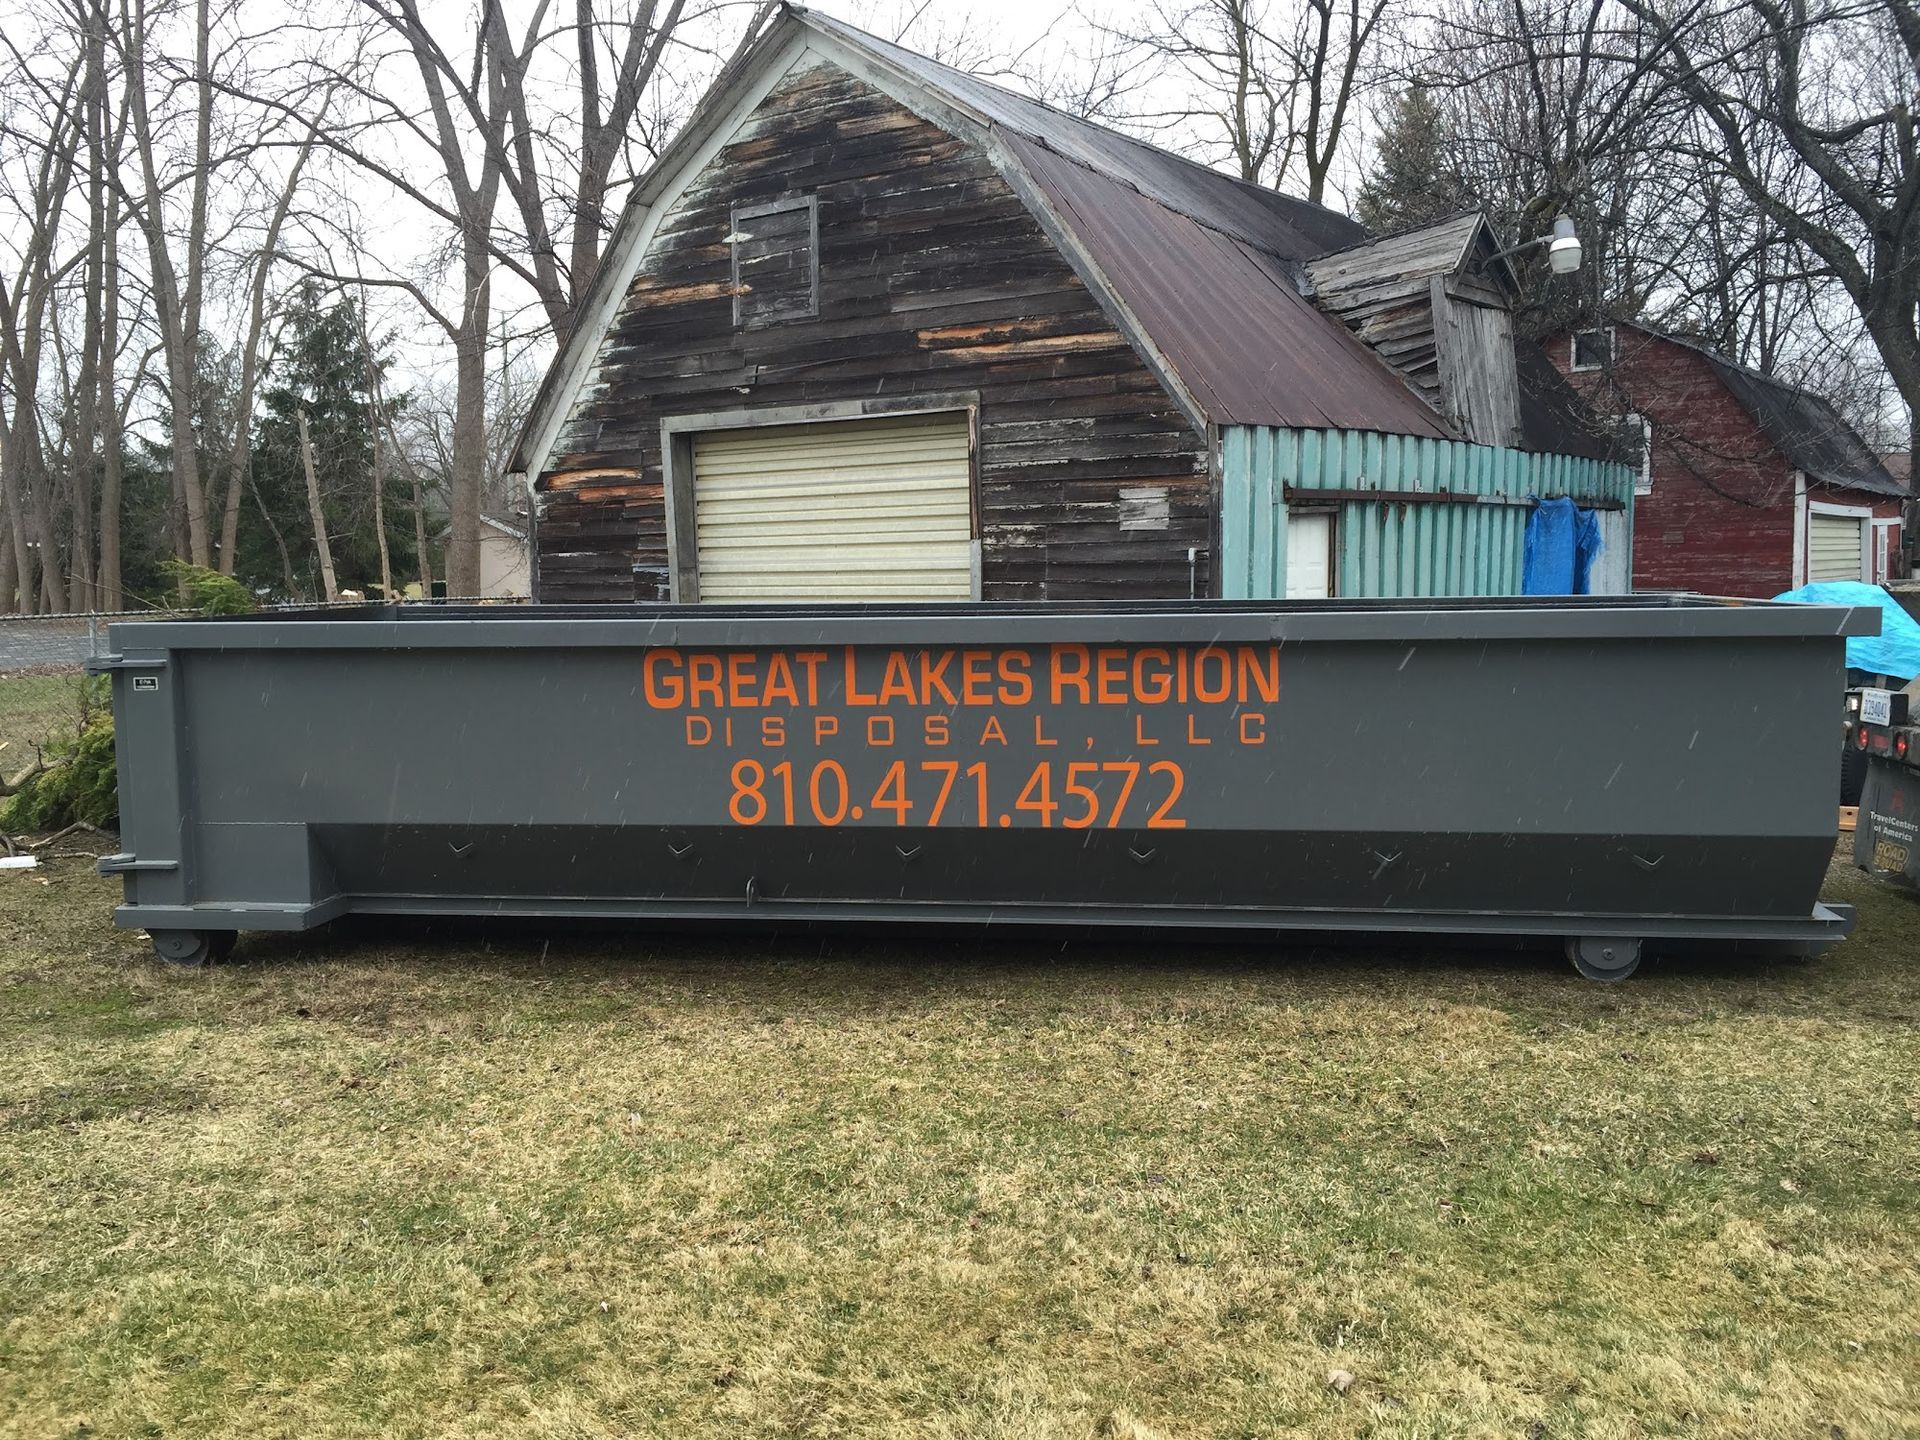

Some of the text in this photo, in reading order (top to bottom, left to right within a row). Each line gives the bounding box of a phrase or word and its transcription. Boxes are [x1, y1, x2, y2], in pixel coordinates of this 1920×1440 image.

[643, 643, 1280, 710] GREAT LAKES REGION
[686, 713, 1265, 750] DISPOSAL, LLC
[728, 758, 1187, 829] 810.471.4572
[1869, 810, 1919, 832] TravelCenters
[1873, 825, 1913, 842] of America
[1877, 842, 1906, 861] ROAD
[1873, 855, 1904, 873] SQUAD
